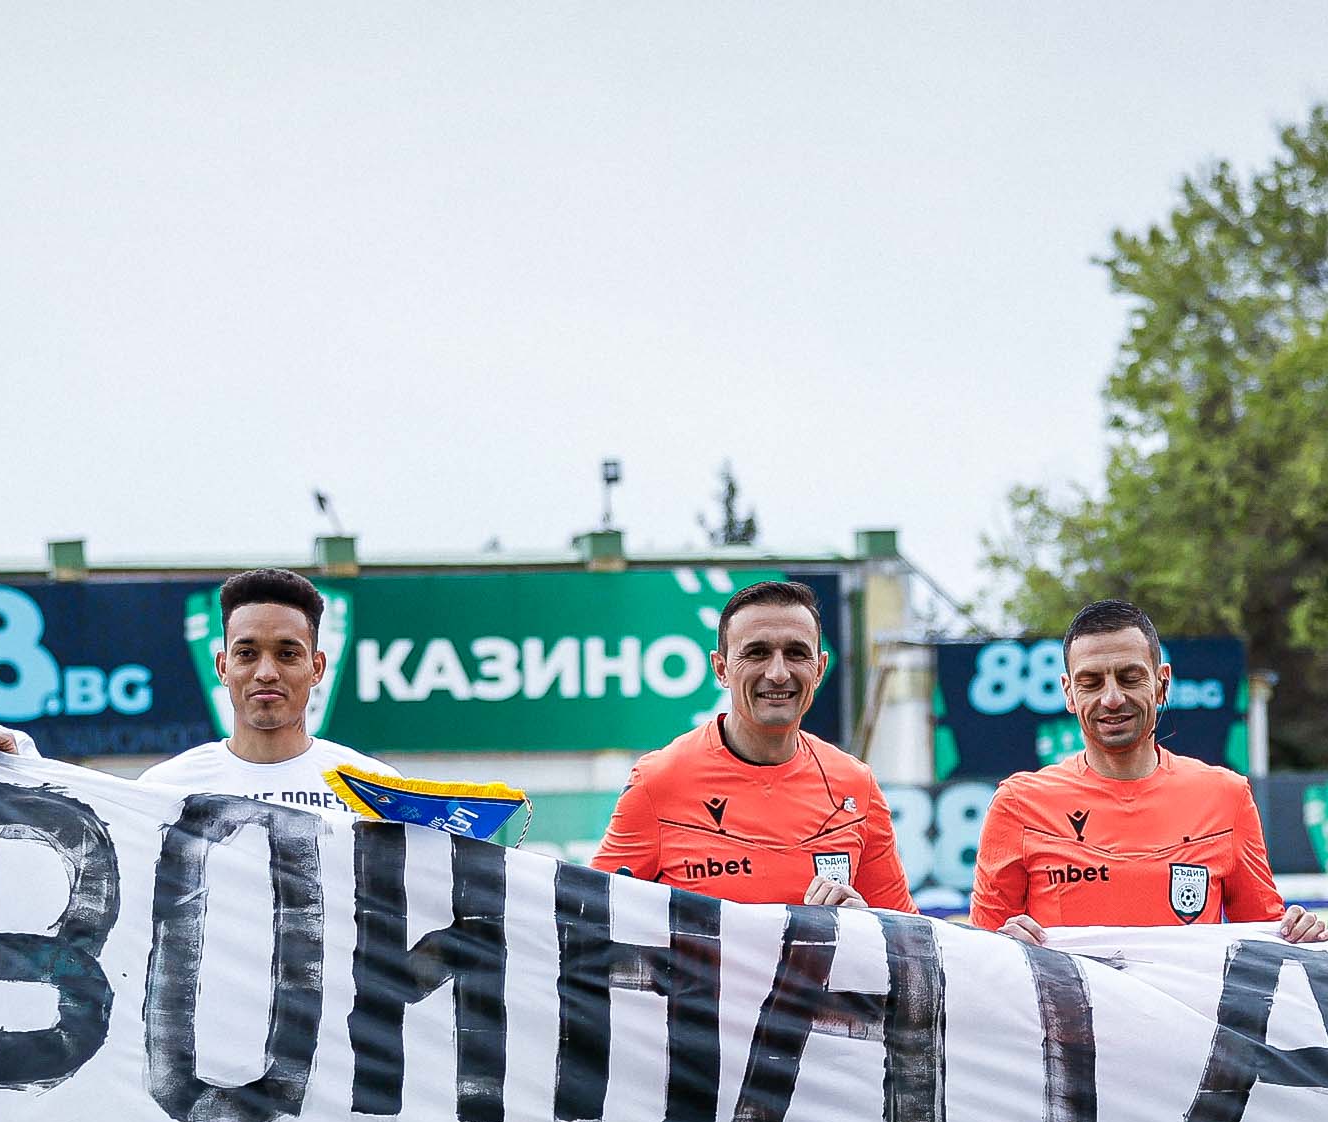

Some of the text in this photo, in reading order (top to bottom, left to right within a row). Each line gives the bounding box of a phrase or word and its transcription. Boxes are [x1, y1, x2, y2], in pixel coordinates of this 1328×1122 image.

[356, 635, 706, 702] КАЗИНО
[684, 857, 752, 879] inbet
[817, 857, 849, 867] СЪДИЯ
[1046, 864, 1109, 884] inbet
[1174, 868, 1205, 877] СЪДИЯ
